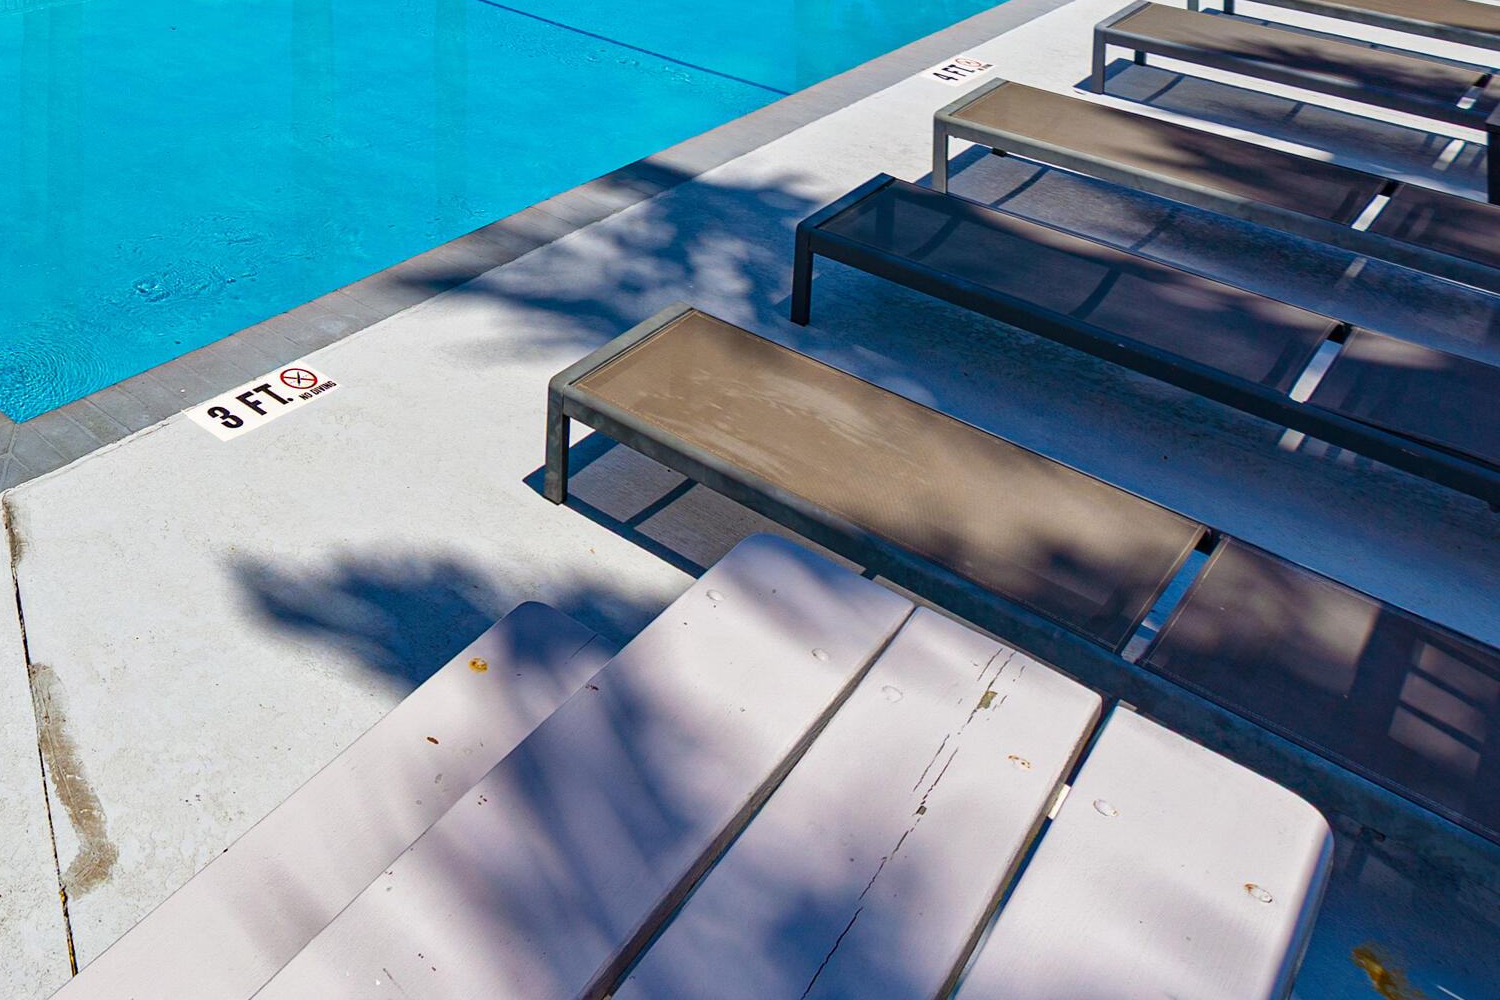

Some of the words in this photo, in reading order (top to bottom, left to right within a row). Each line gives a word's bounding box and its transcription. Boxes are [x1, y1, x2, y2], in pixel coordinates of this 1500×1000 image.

[932, 72, 959, 81] 4
[298, 392, 313, 401] NO
[310, 381, 337, 396] DIVING
[207, 406, 244, 429] 3
[235, 383, 294, 416] FT.
